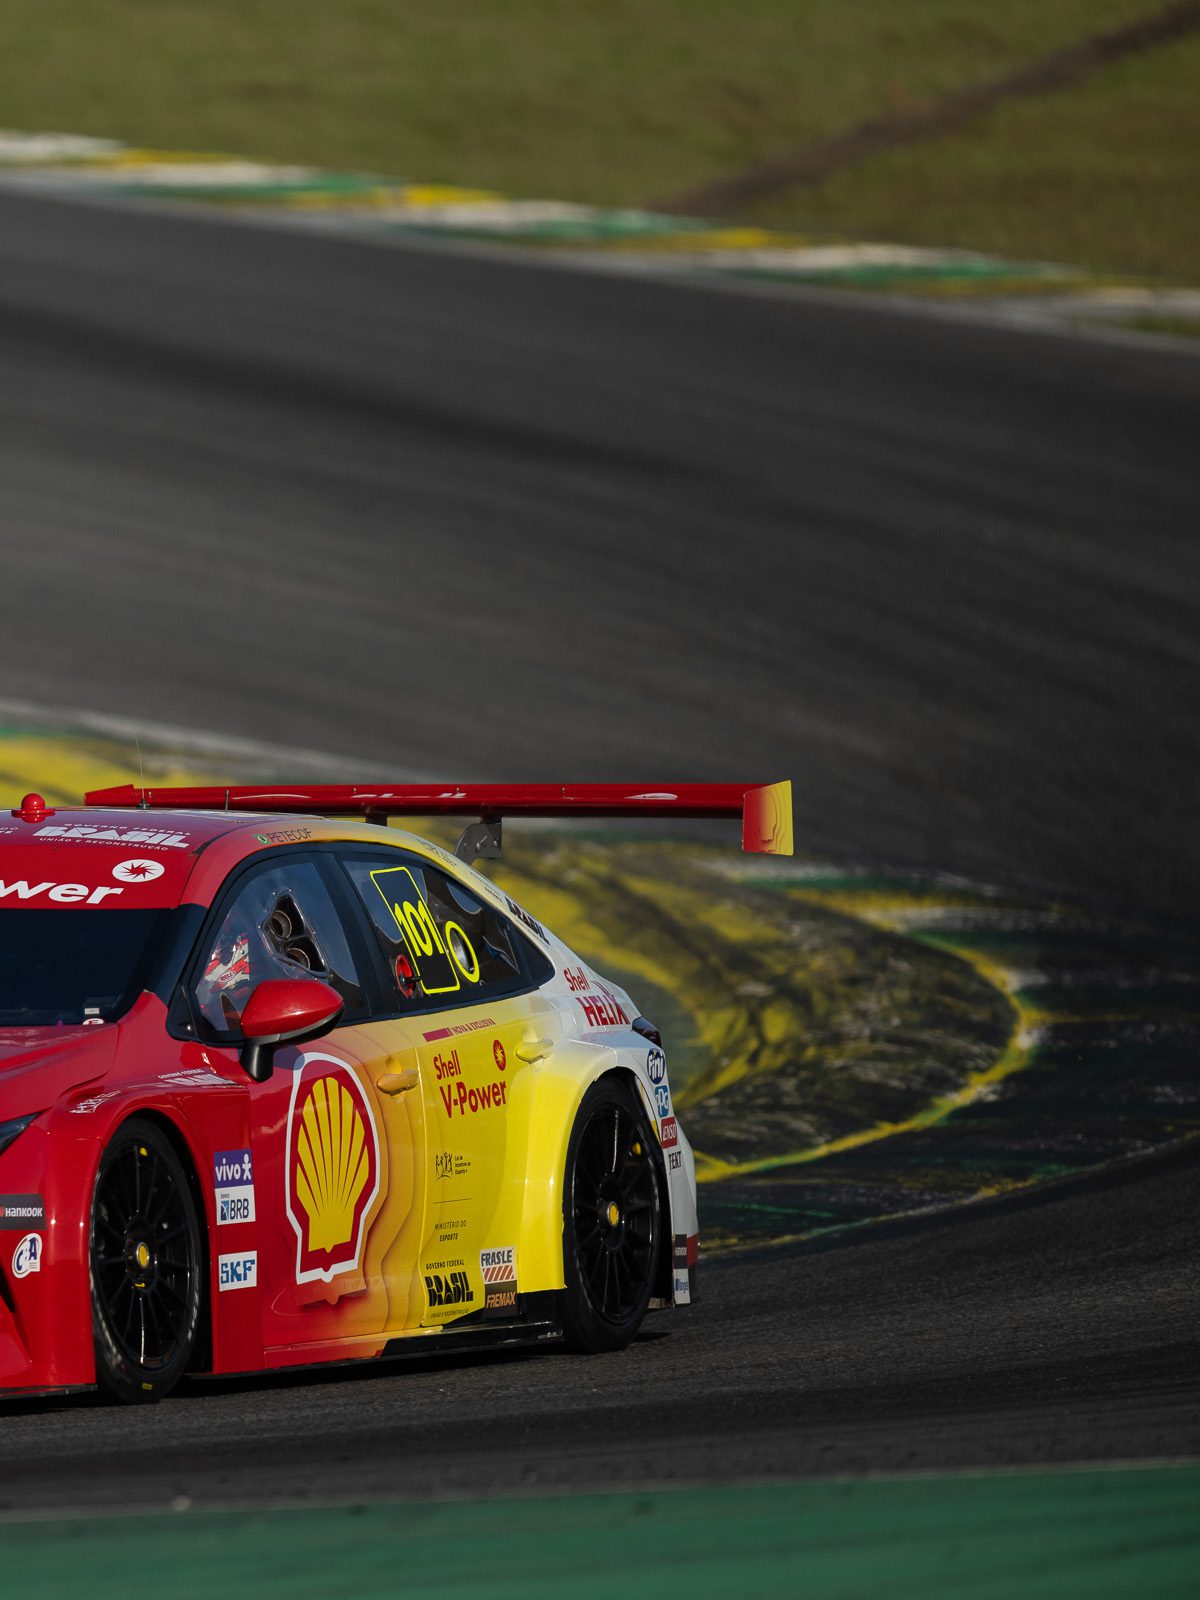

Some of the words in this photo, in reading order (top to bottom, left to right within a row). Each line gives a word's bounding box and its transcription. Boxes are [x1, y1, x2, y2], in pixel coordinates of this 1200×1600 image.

[32, 826, 190, 848] BRASIL
[266, 828, 312, 843] PETECOF
[394, 900, 445, 957] 101
[563, 966, 591, 992] Shell
[575, 994, 631, 1027] HELIX
[433, 1049, 462, 1081] Shell
[439, 1081, 507, 1119] V-Power
[215, 1157, 242, 1182] vivo
[229, 1198, 250, 1220] BRB
[439, 1232, 459, 1242] ESPORTE
[220, 1259, 256, 1285] SKF
[425, 1260, 446, 1270] GOVERNO
[446, 1258, 465, 1268] FEDERAL
[424, 1271, 474, 1307] BRASIL
[486, 1290, 517, 1309] FREMAX
